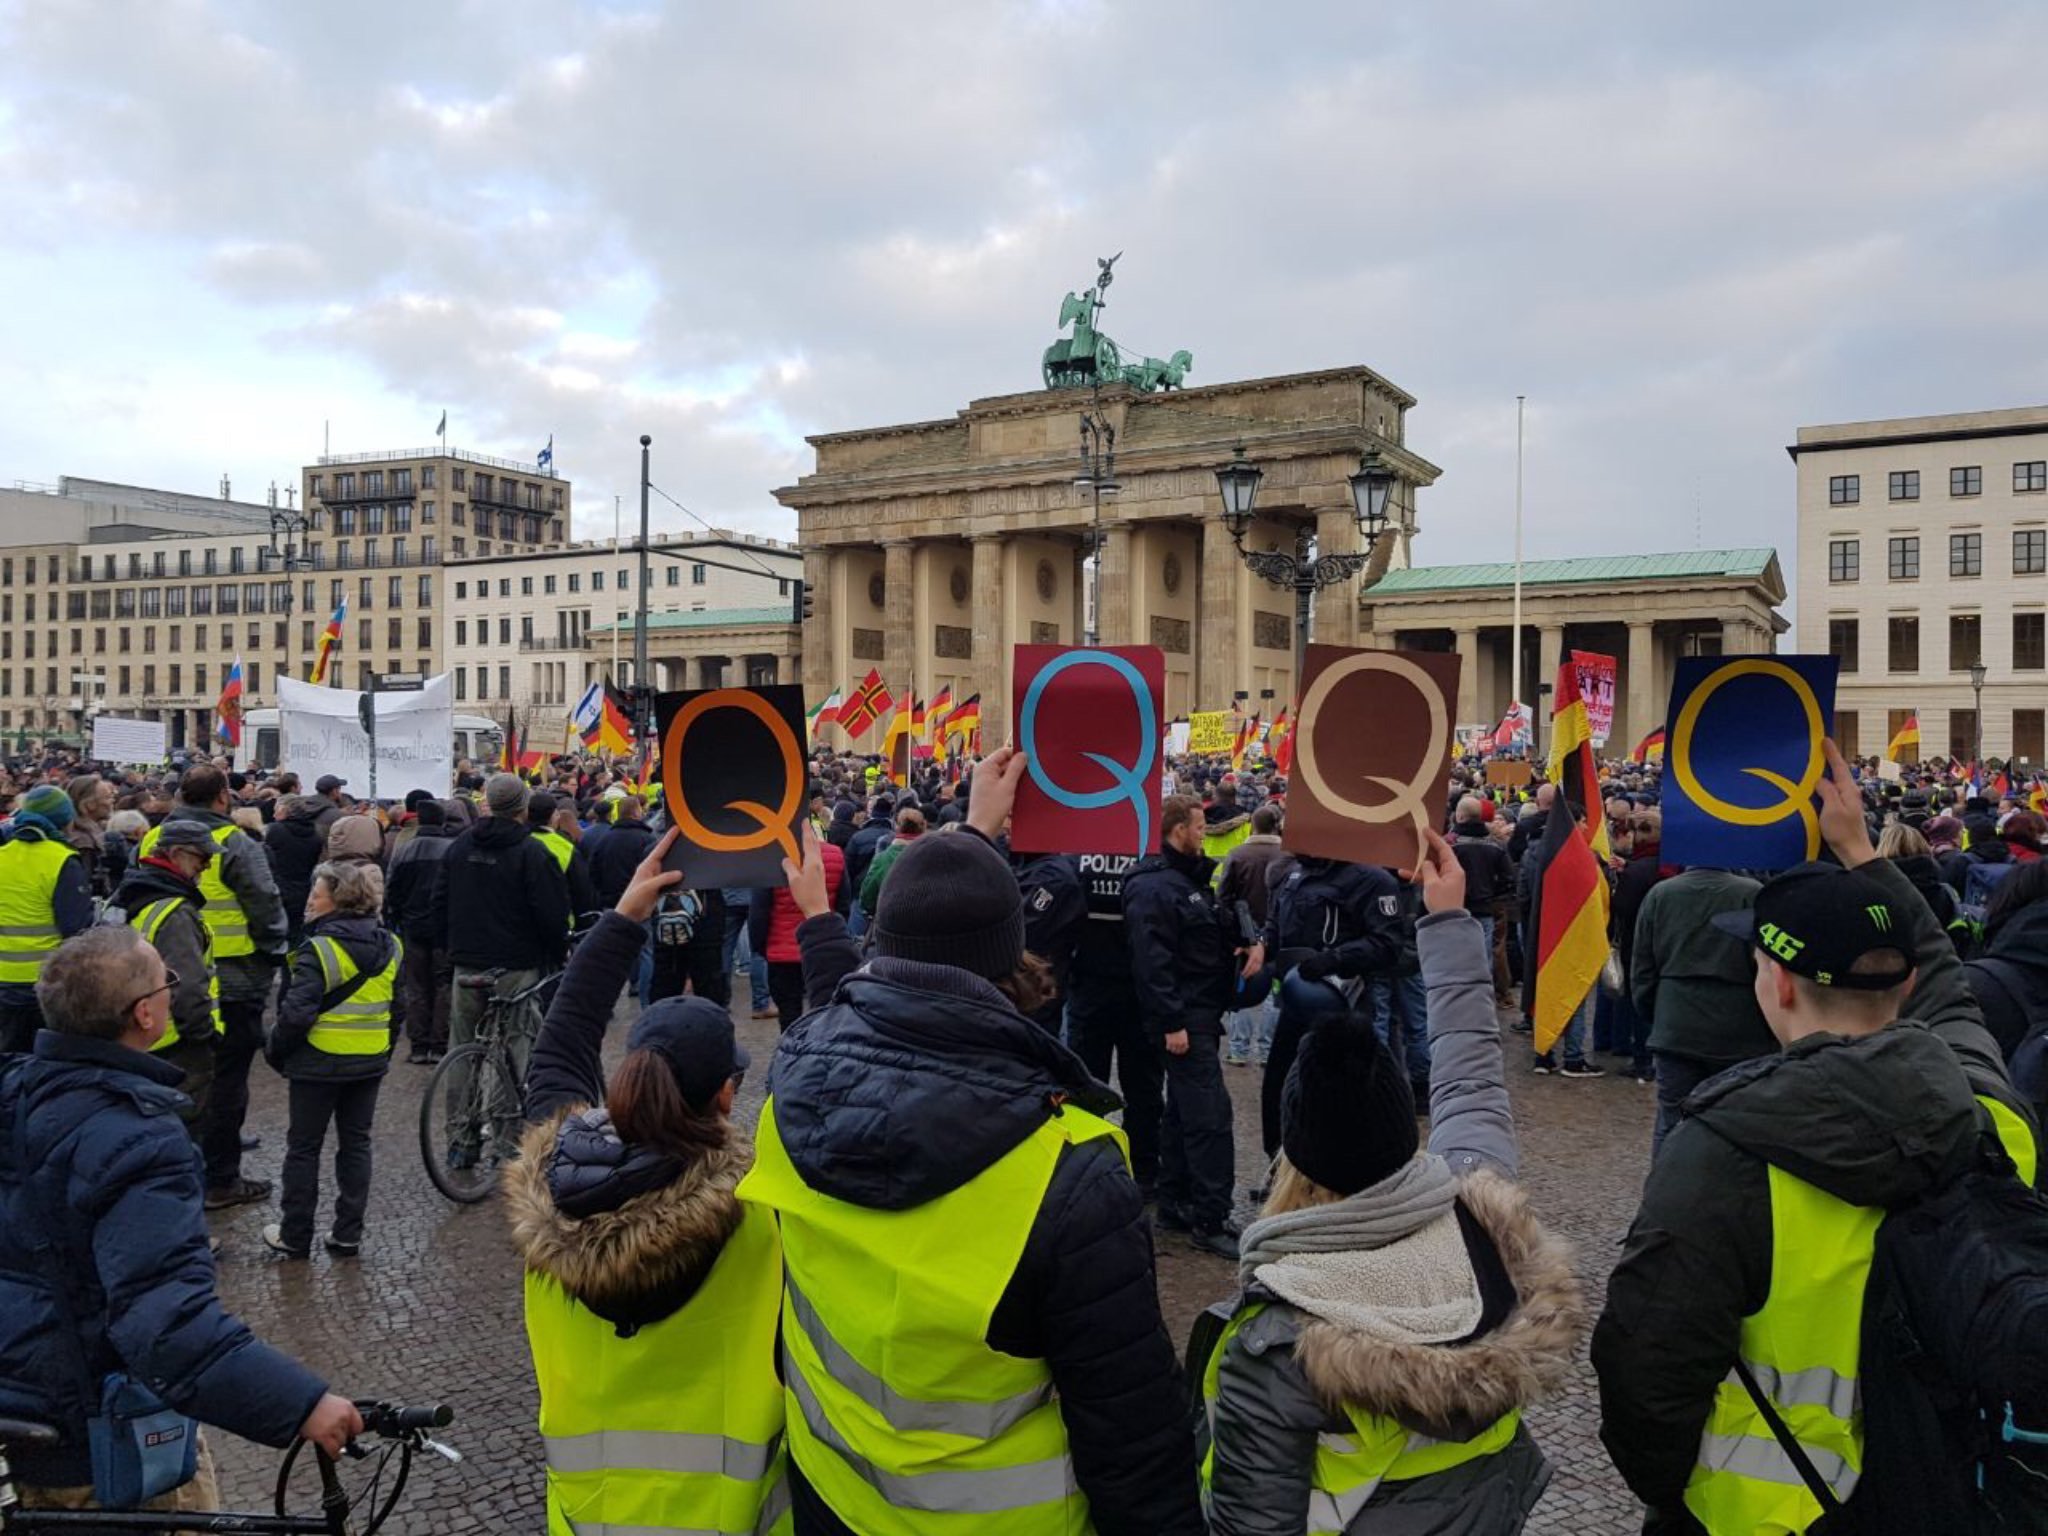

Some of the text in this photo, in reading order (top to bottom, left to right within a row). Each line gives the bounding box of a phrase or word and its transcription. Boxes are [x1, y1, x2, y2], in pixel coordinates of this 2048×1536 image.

[663, 689, 804, 871] Q
[1020, 650, 1156, 861] Q
[1297, 652, 1448, 882] Q
[1672, 658, 1826, 864] Q
[1760, 923, 1805, 961] 46
